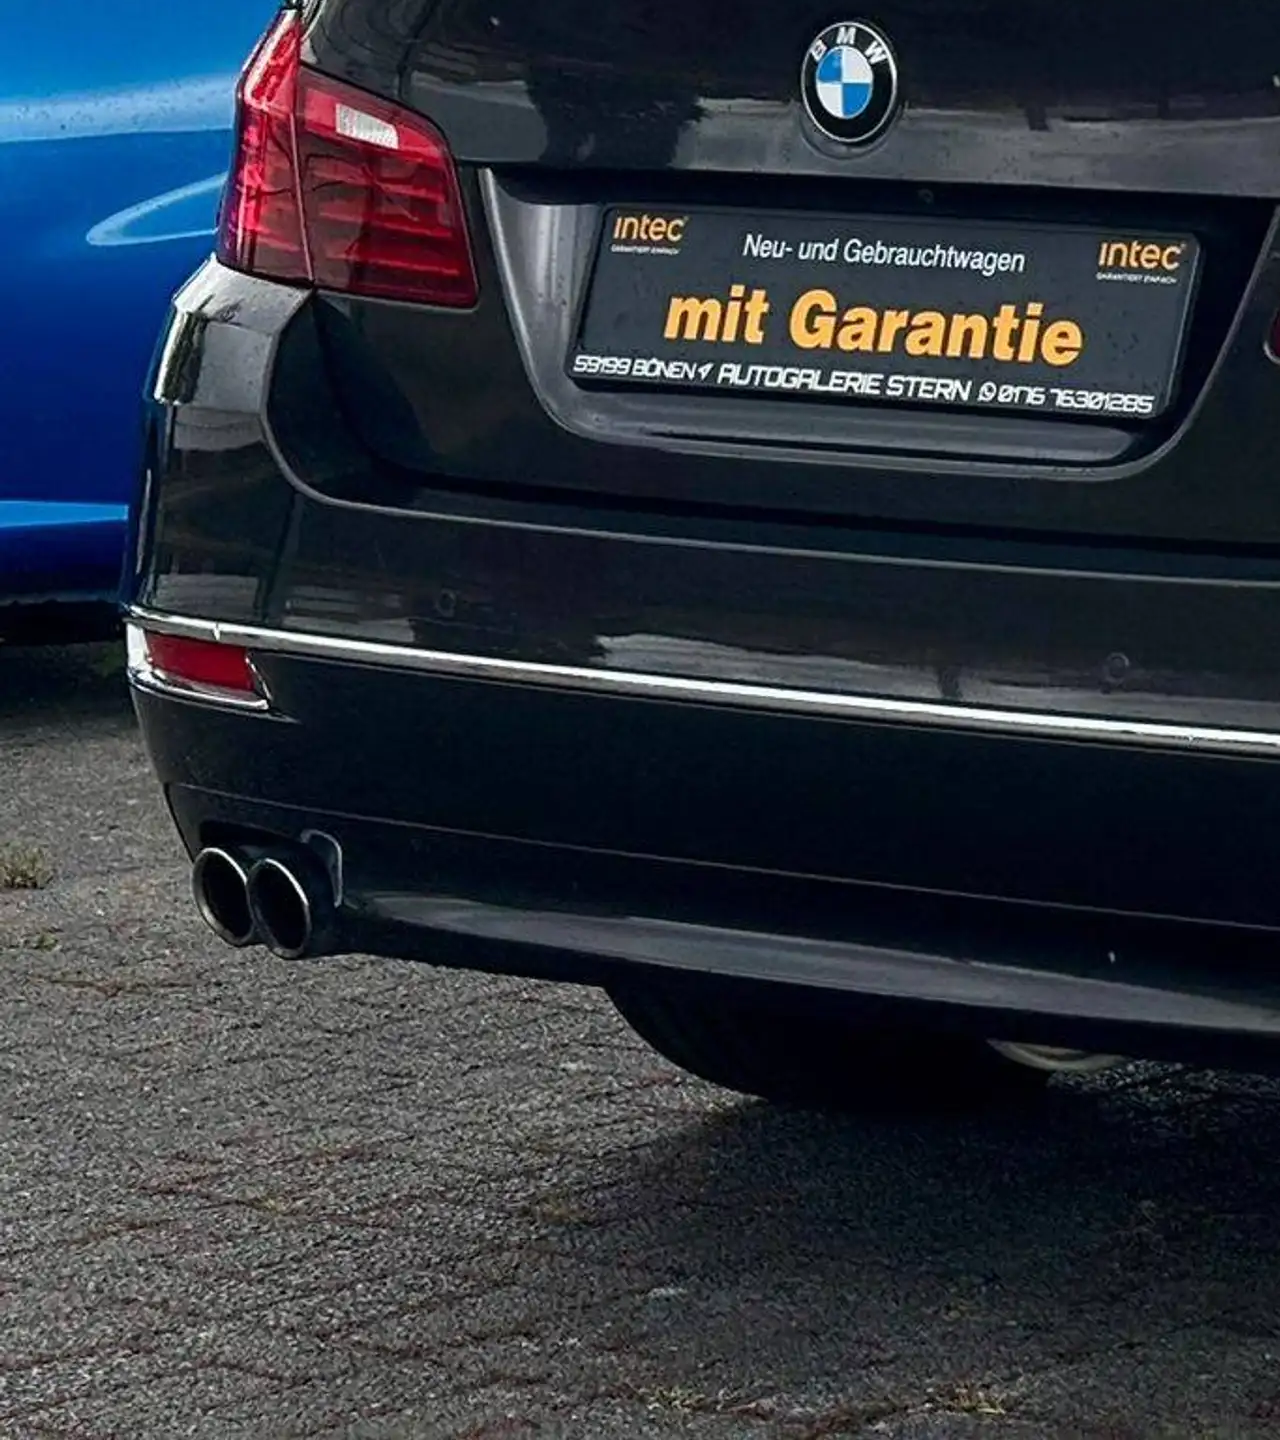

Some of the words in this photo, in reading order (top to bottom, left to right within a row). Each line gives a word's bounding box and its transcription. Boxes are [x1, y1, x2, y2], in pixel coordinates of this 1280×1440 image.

[810, 25, 887, 65] BMW
[613, 213, 685, 242] intec
[743, 233, 793, 259] Neu-
[798, 238, 839, 262] und
[843, 238, 1026, 277] Gebrauchtwagen
[1098, 240, 1182, 271] intec
[663, 284, 770, 345] mit
[789, 288, 1084, 366] Garantie
[573, 355, 631, 375] 59199
[717, 361, 884, 397] AUTOGALERIE
[886, 376, 972, 402] STERN
[997, 383, 1045, 406] 0176
[1049, 387, 1156, 414] 76301285
